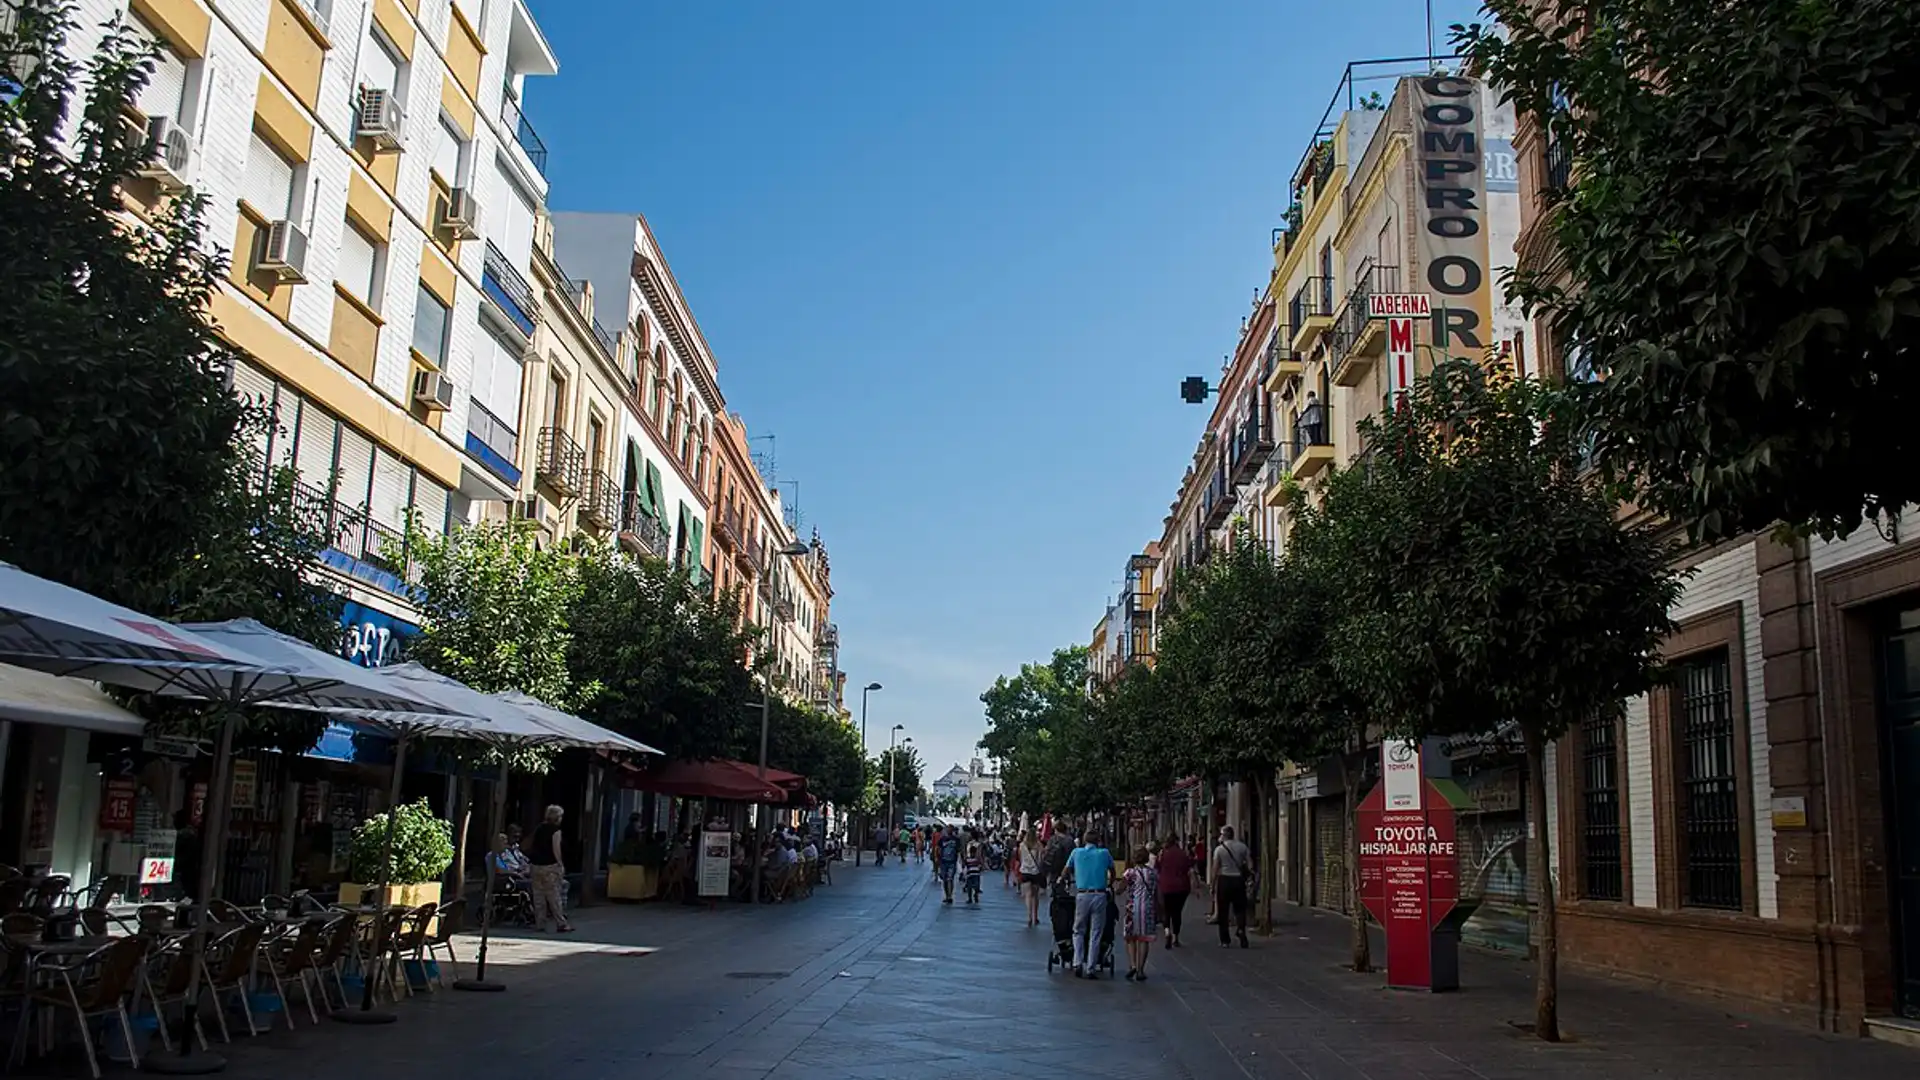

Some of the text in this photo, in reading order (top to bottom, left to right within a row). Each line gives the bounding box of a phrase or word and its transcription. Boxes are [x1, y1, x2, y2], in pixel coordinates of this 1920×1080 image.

[1422, 77, 1479, 238] COMPRO
[1370, 296, 1430, 314] TABERNA
[1374, 826, 1438, 841] TOYOTA
